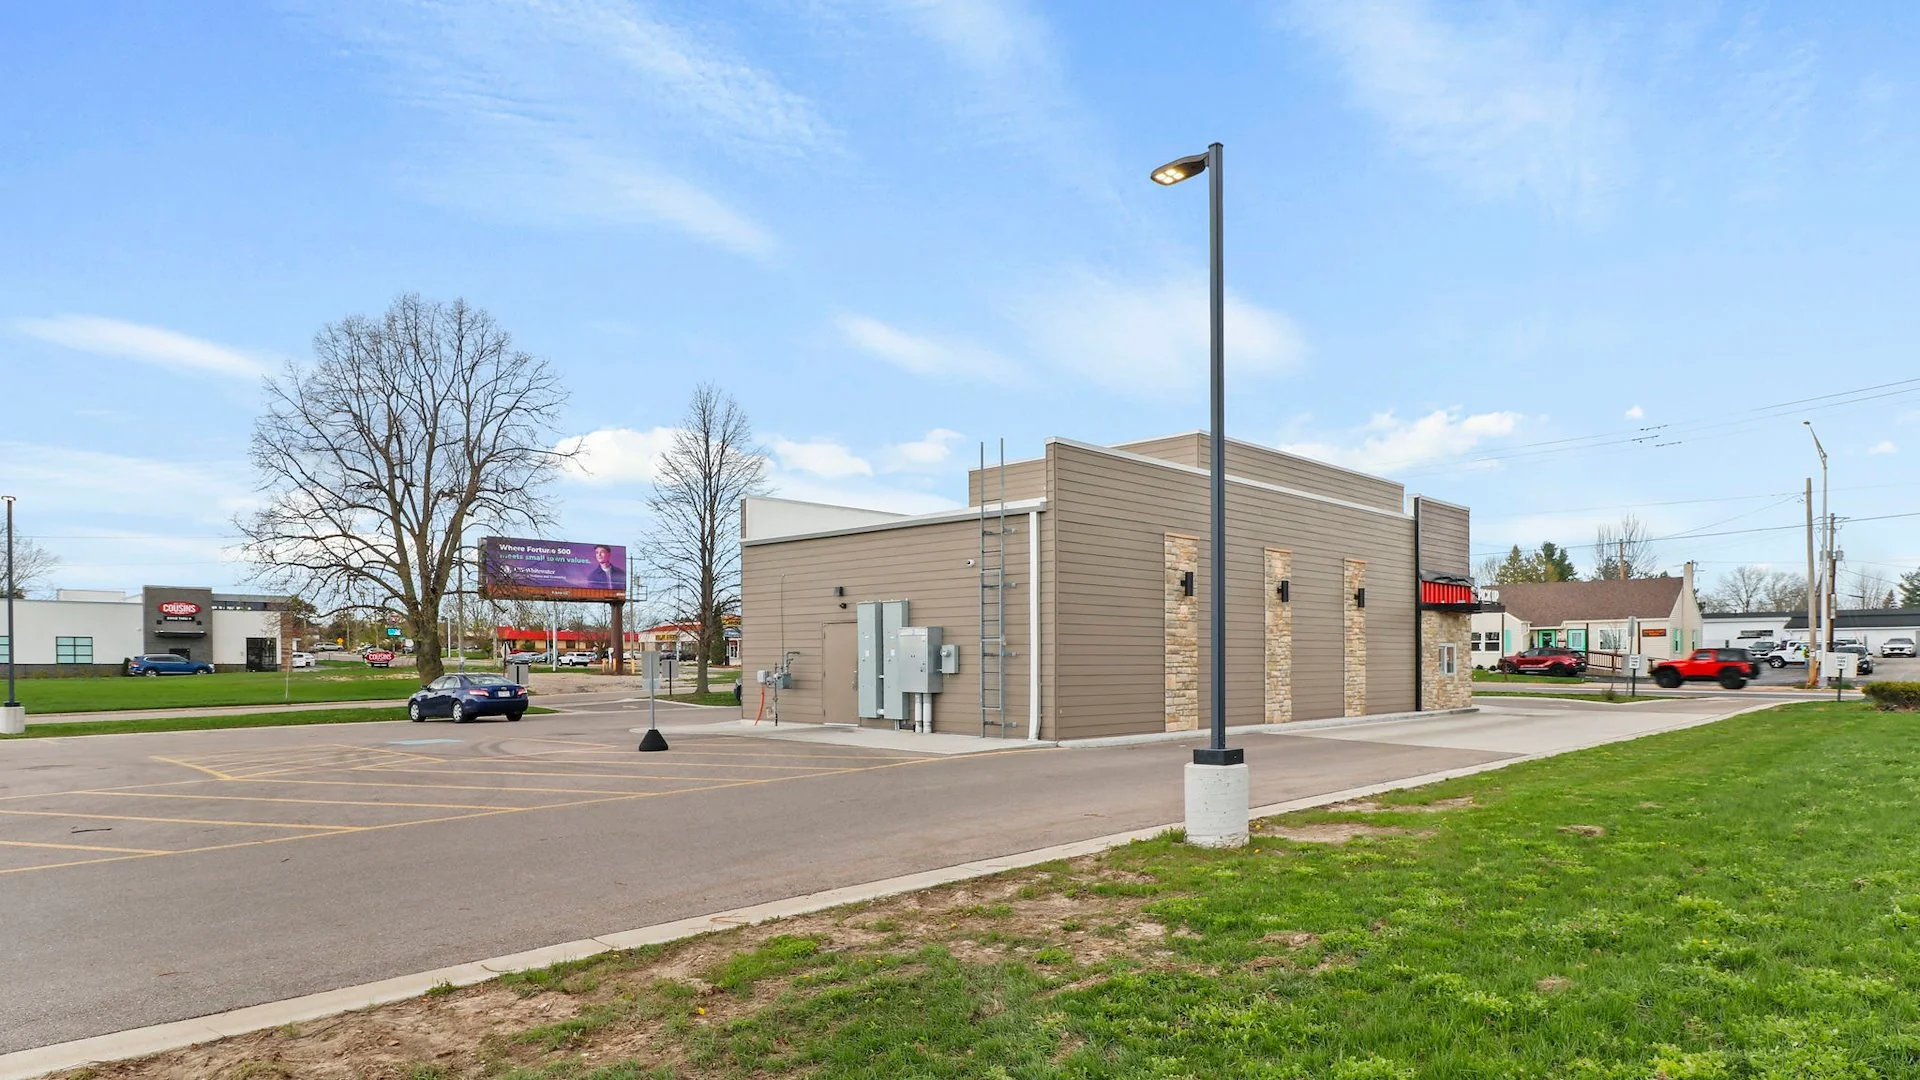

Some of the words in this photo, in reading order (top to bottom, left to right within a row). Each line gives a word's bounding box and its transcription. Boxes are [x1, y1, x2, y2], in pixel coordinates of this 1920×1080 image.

[499, 544, 525, 552] Where
[557, 547, 571, 555] 500
[163, 604, 196, 612] COUSINS
